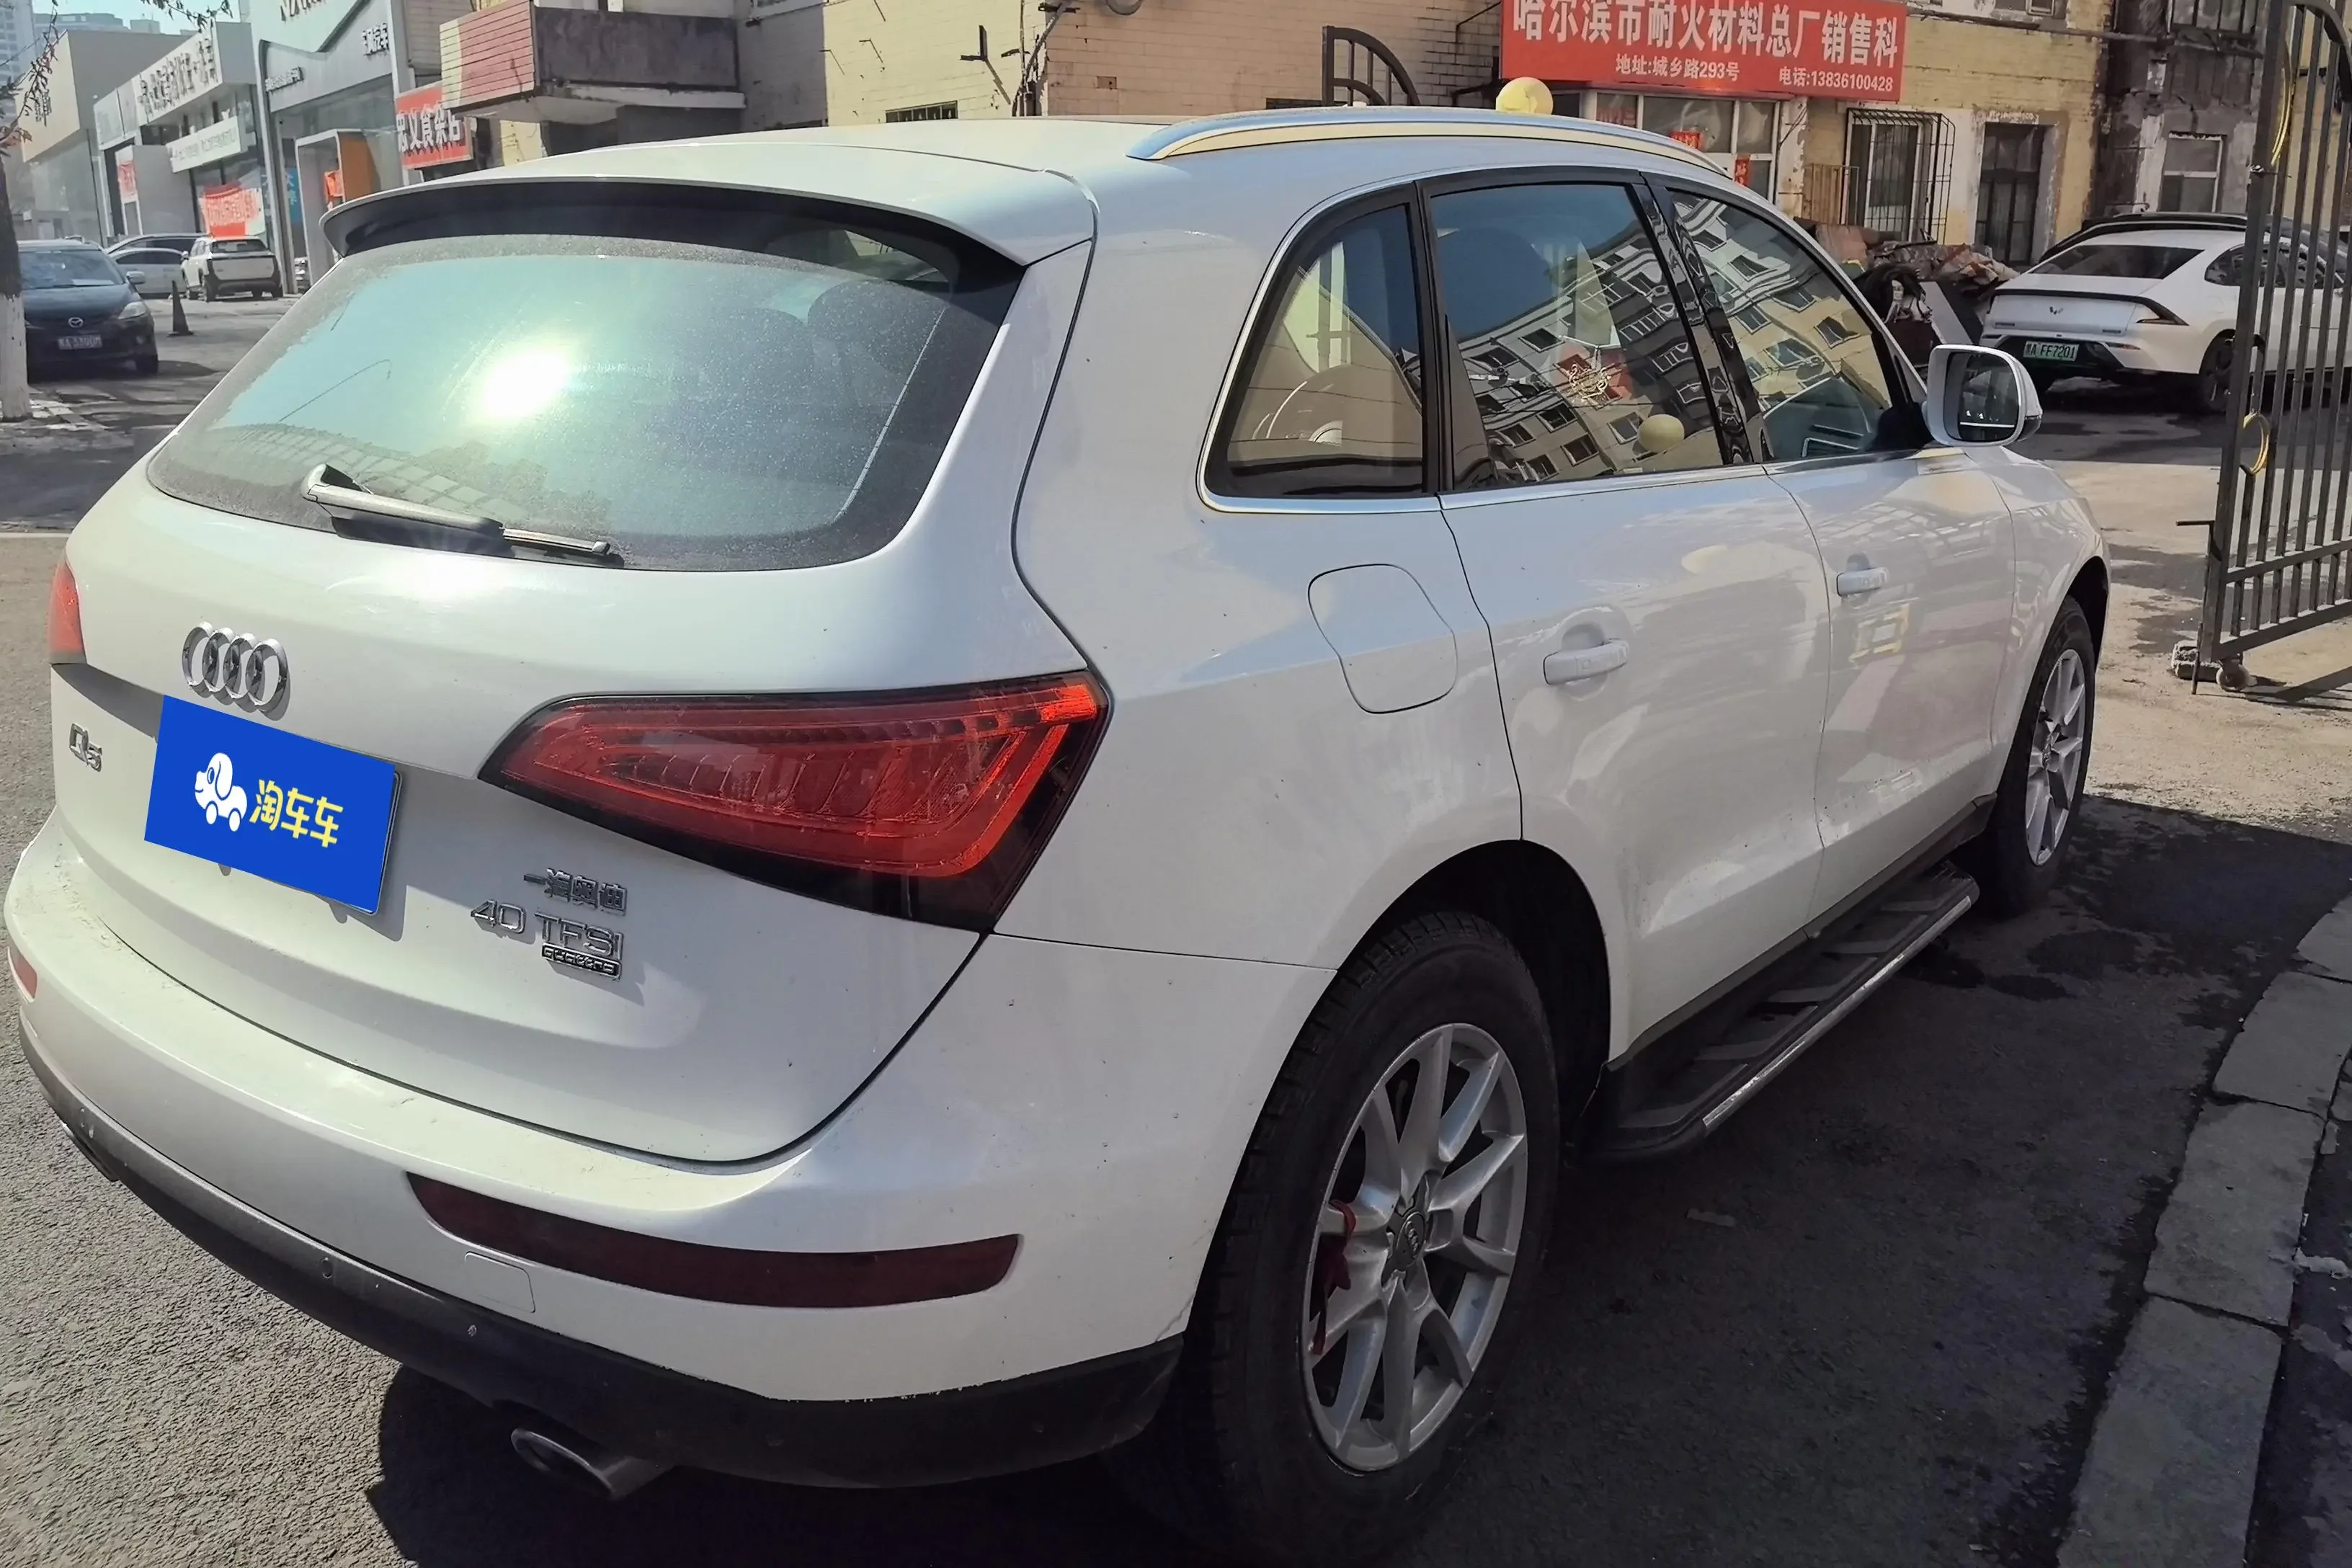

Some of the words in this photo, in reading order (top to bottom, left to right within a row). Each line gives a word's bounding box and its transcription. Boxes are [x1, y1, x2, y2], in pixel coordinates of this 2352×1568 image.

[1513, 0, 1898, 68] 哈尔滨市耐火材料总厂销售科
[69, 723, 102, 772] Q5
[471, 899, 527, 934] 40
[534, 911, 625, 961] TFSI
